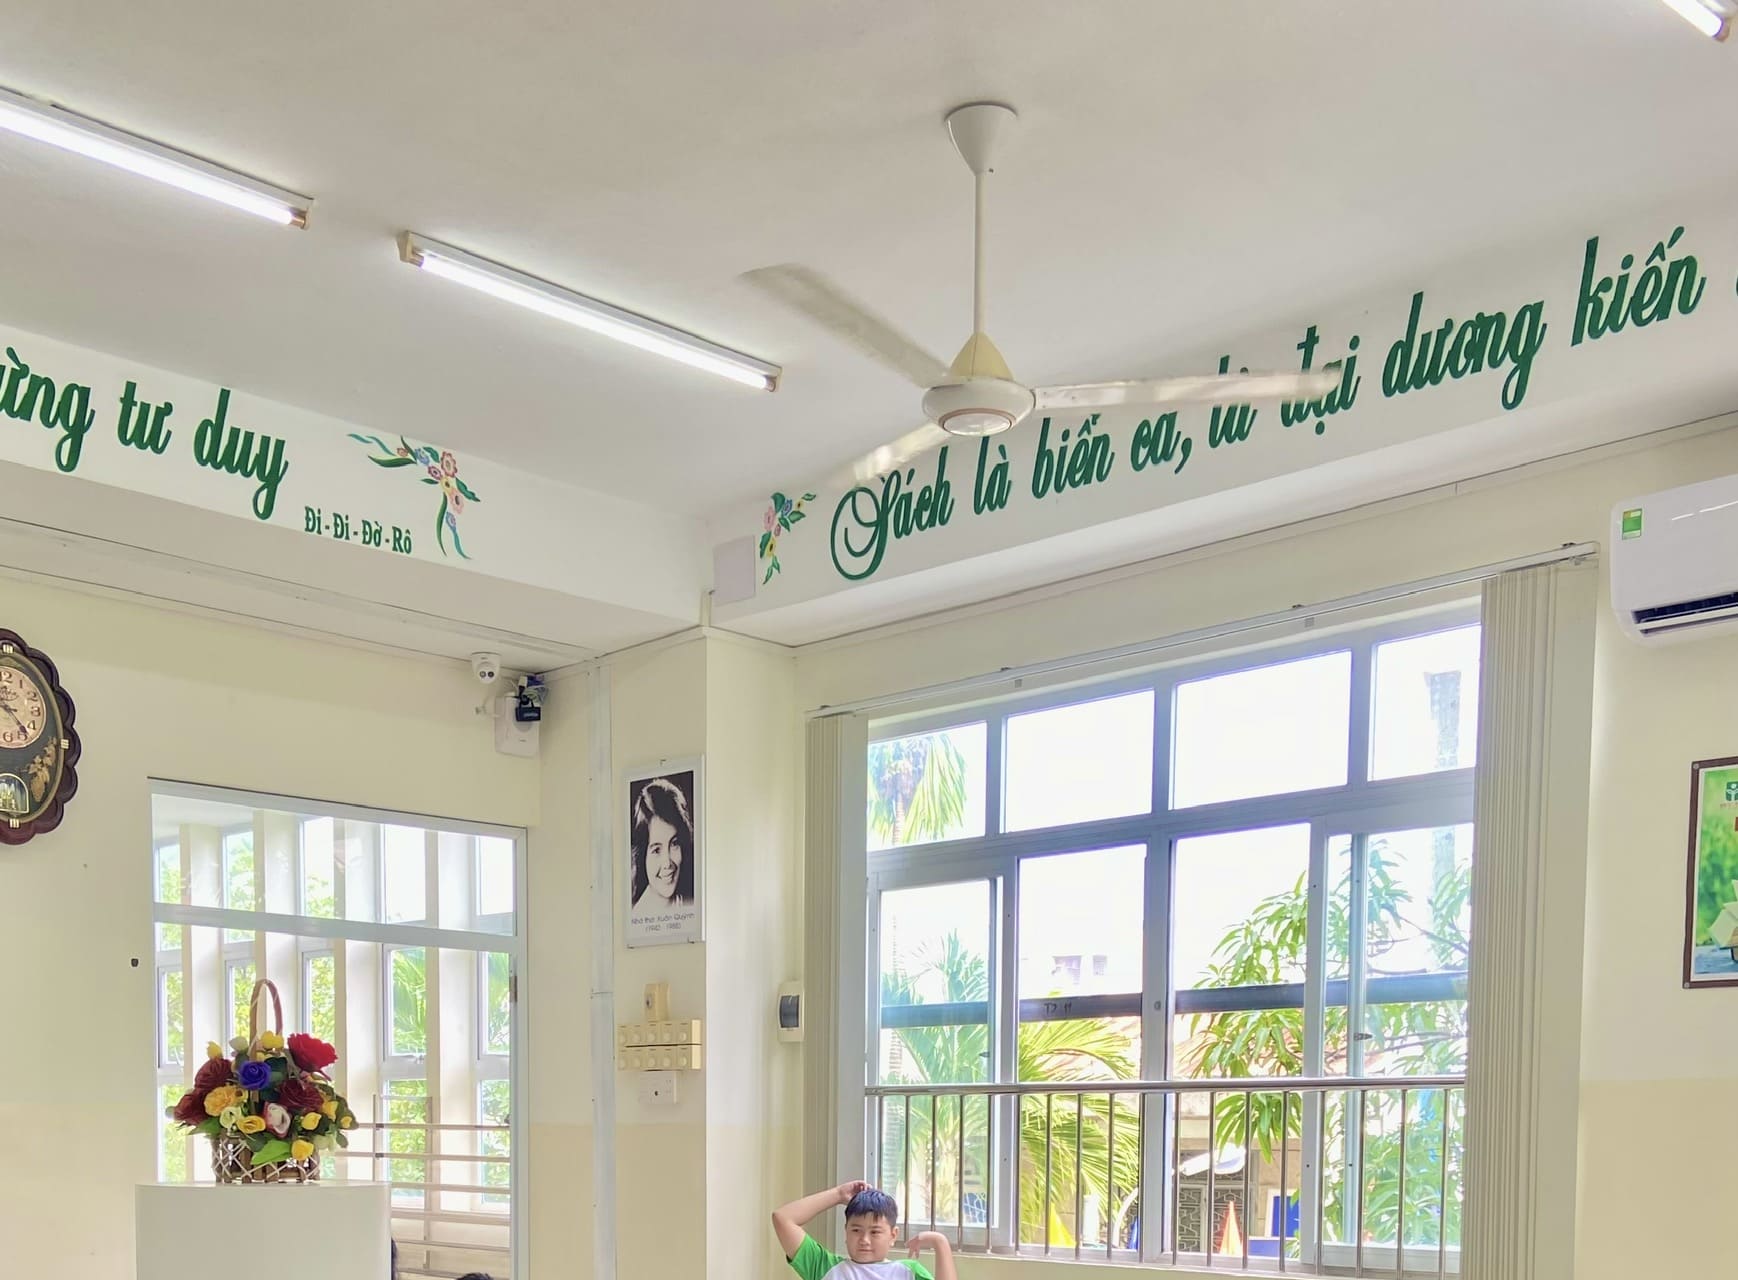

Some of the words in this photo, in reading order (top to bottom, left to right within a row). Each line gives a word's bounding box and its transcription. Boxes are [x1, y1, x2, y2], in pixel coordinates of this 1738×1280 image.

[117, 380, 173, 455] tư
[193, 388, 289, 520] duy
[830, 445, 954, 580] Sách
[974, 435, 1012, 515] là
[1032, 412, 1115, 499] biển
[1382, 291, 1547, 410] dương
[1571, 226, 1707, 347] kiến
